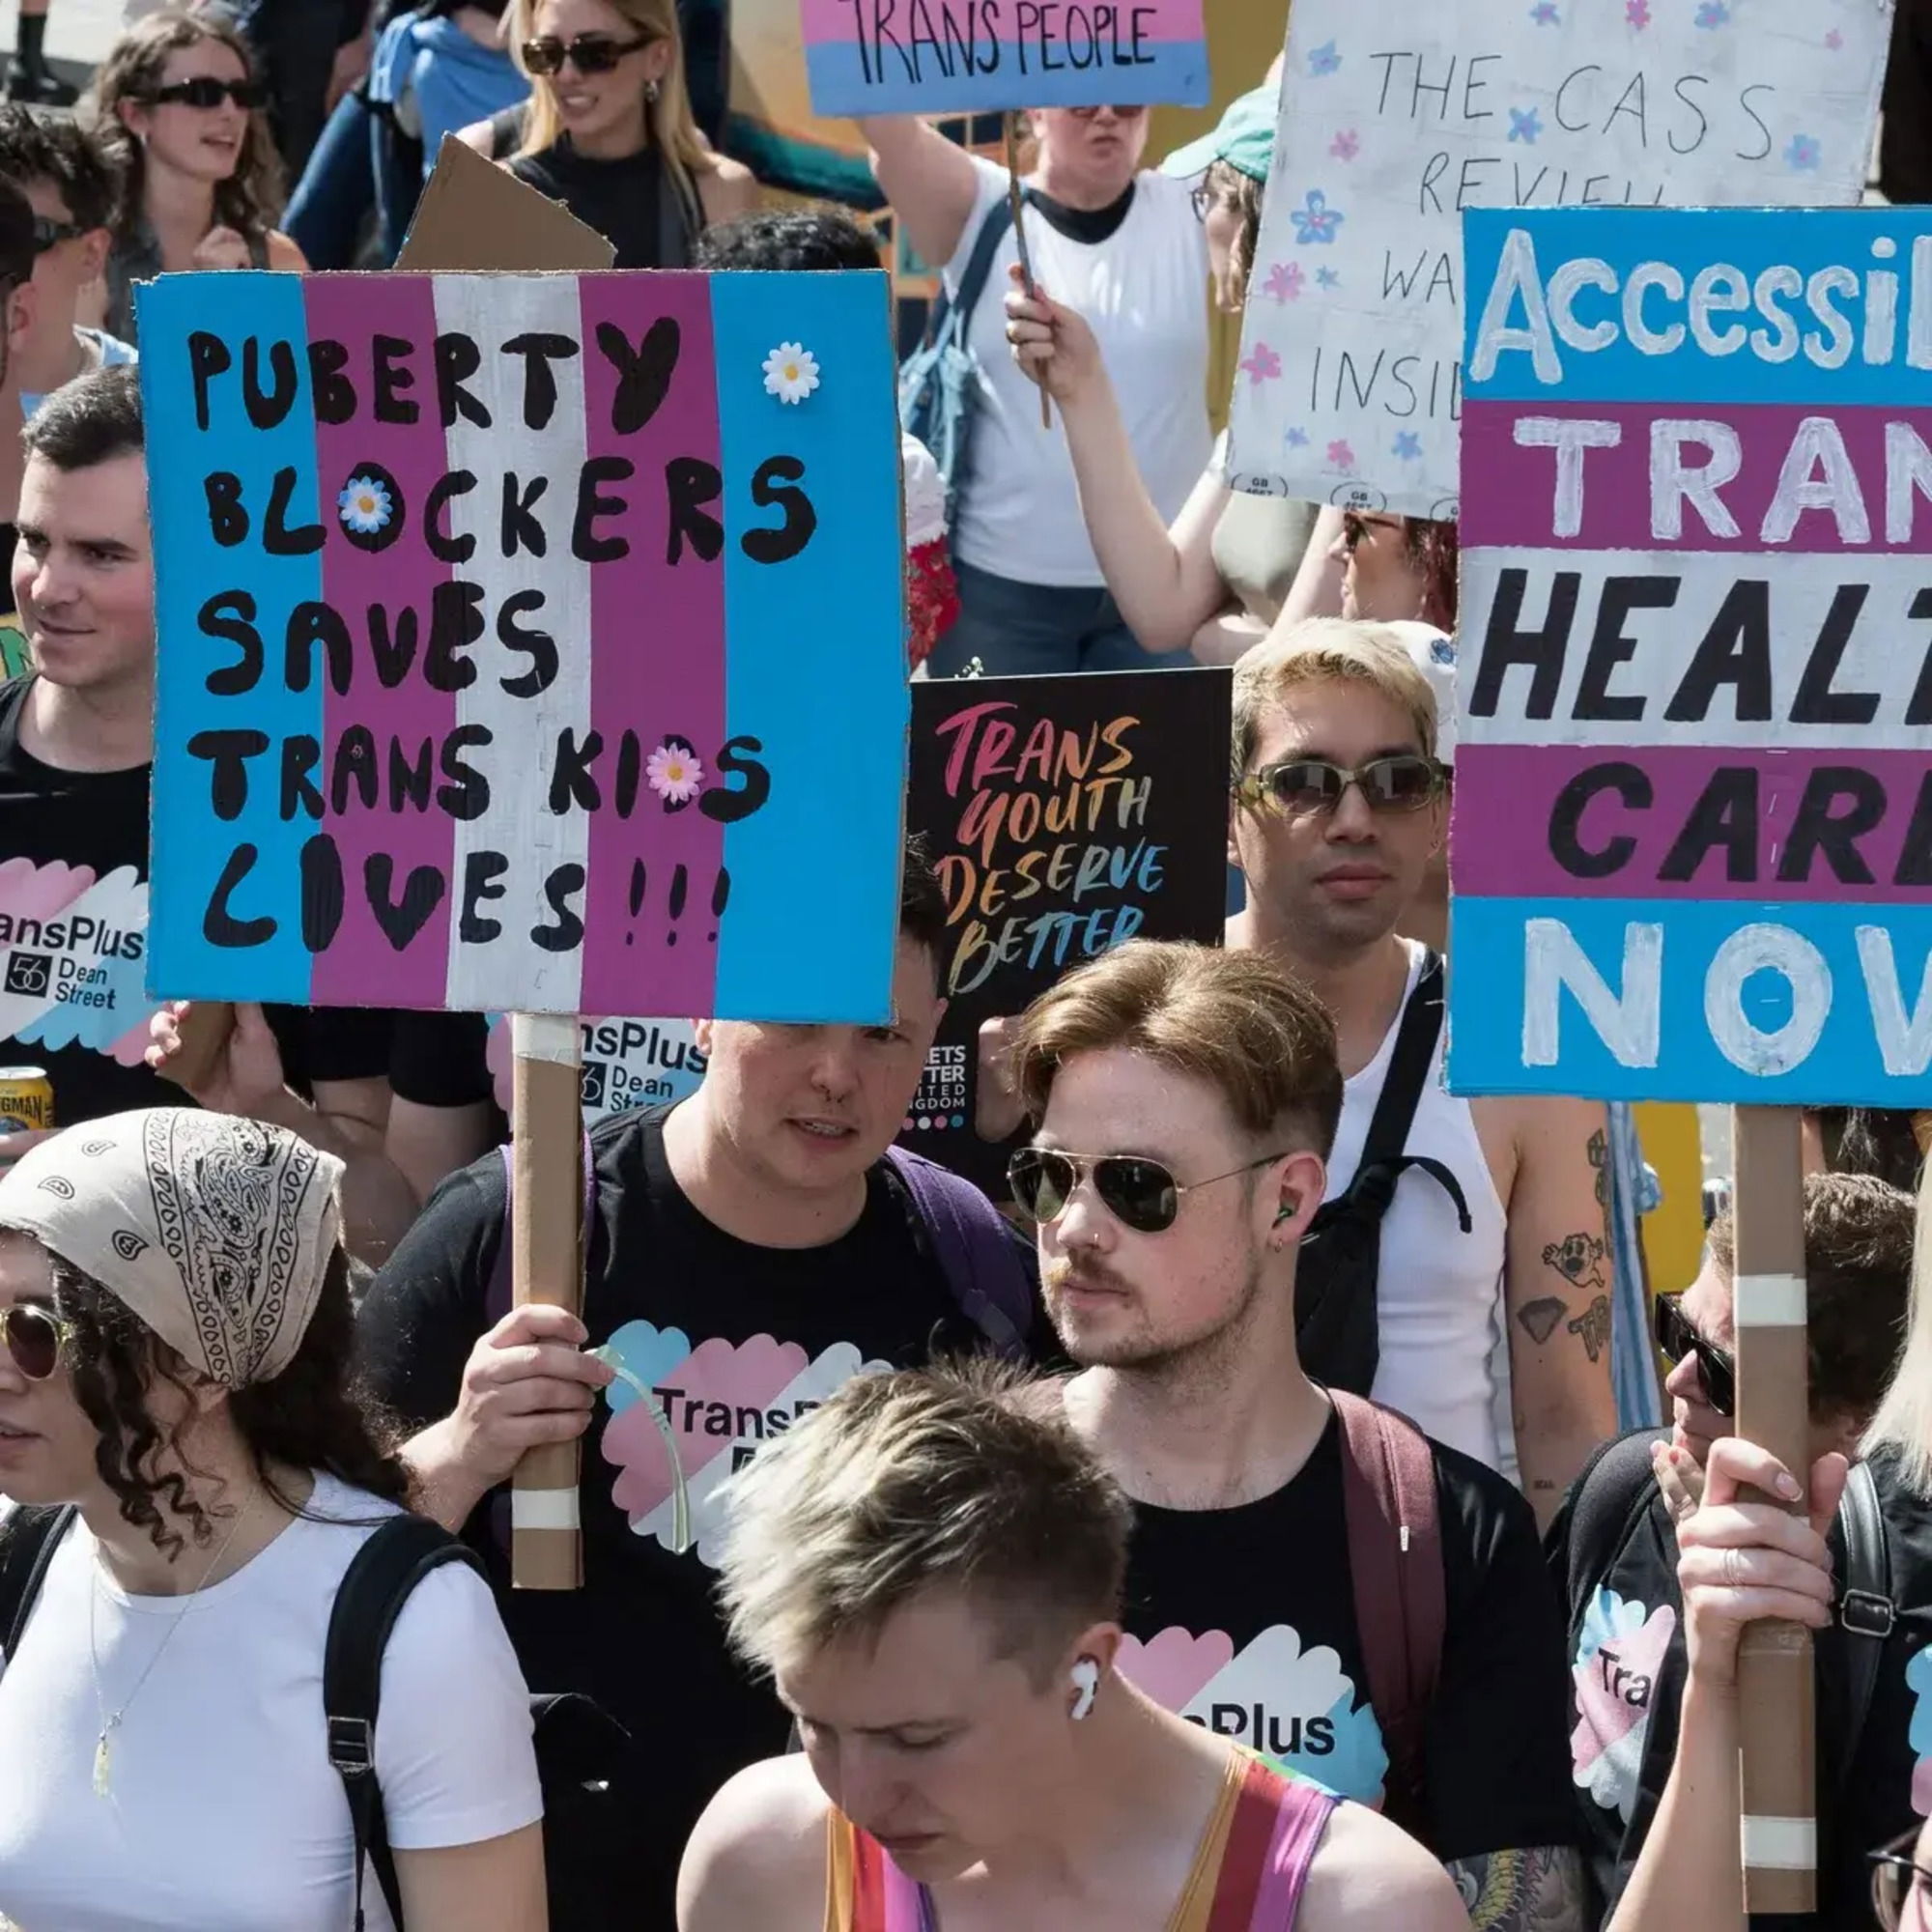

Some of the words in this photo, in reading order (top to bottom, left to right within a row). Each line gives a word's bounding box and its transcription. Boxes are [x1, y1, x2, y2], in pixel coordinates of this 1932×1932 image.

[838, 0, 1000, 84] TRANS
[1017, 3, 1156, 75] PEOPLE
[1370, 52, 1502, 120] THE
[1556, 65, 1776, 160] CASS
[188, 316, 681, 436] PUBERTY
[1311, 348, 1461, 420] INSI
[205, 457, 816, 566] BLOCKERS
[197, 581, 559, 698] SAVES
[188, 724, 493, 821] TRANS
[935, 701, 1141, 798] TRANS
[955, 776, 1152, 869] YOUTH
[933, 837, 1169, 927] DESERVE
[55, 981, 116, 1009] Street
[58, 957, 107, 985] Dean
[581, 1065, 602, 1101] 6
[611, 1065, 673, 1097] Dean
[926, 1045, 966, 1065] ETS
[652, 1387, 820, 1439] Trans
[1183, 1703, 1336, 1755] Plus
